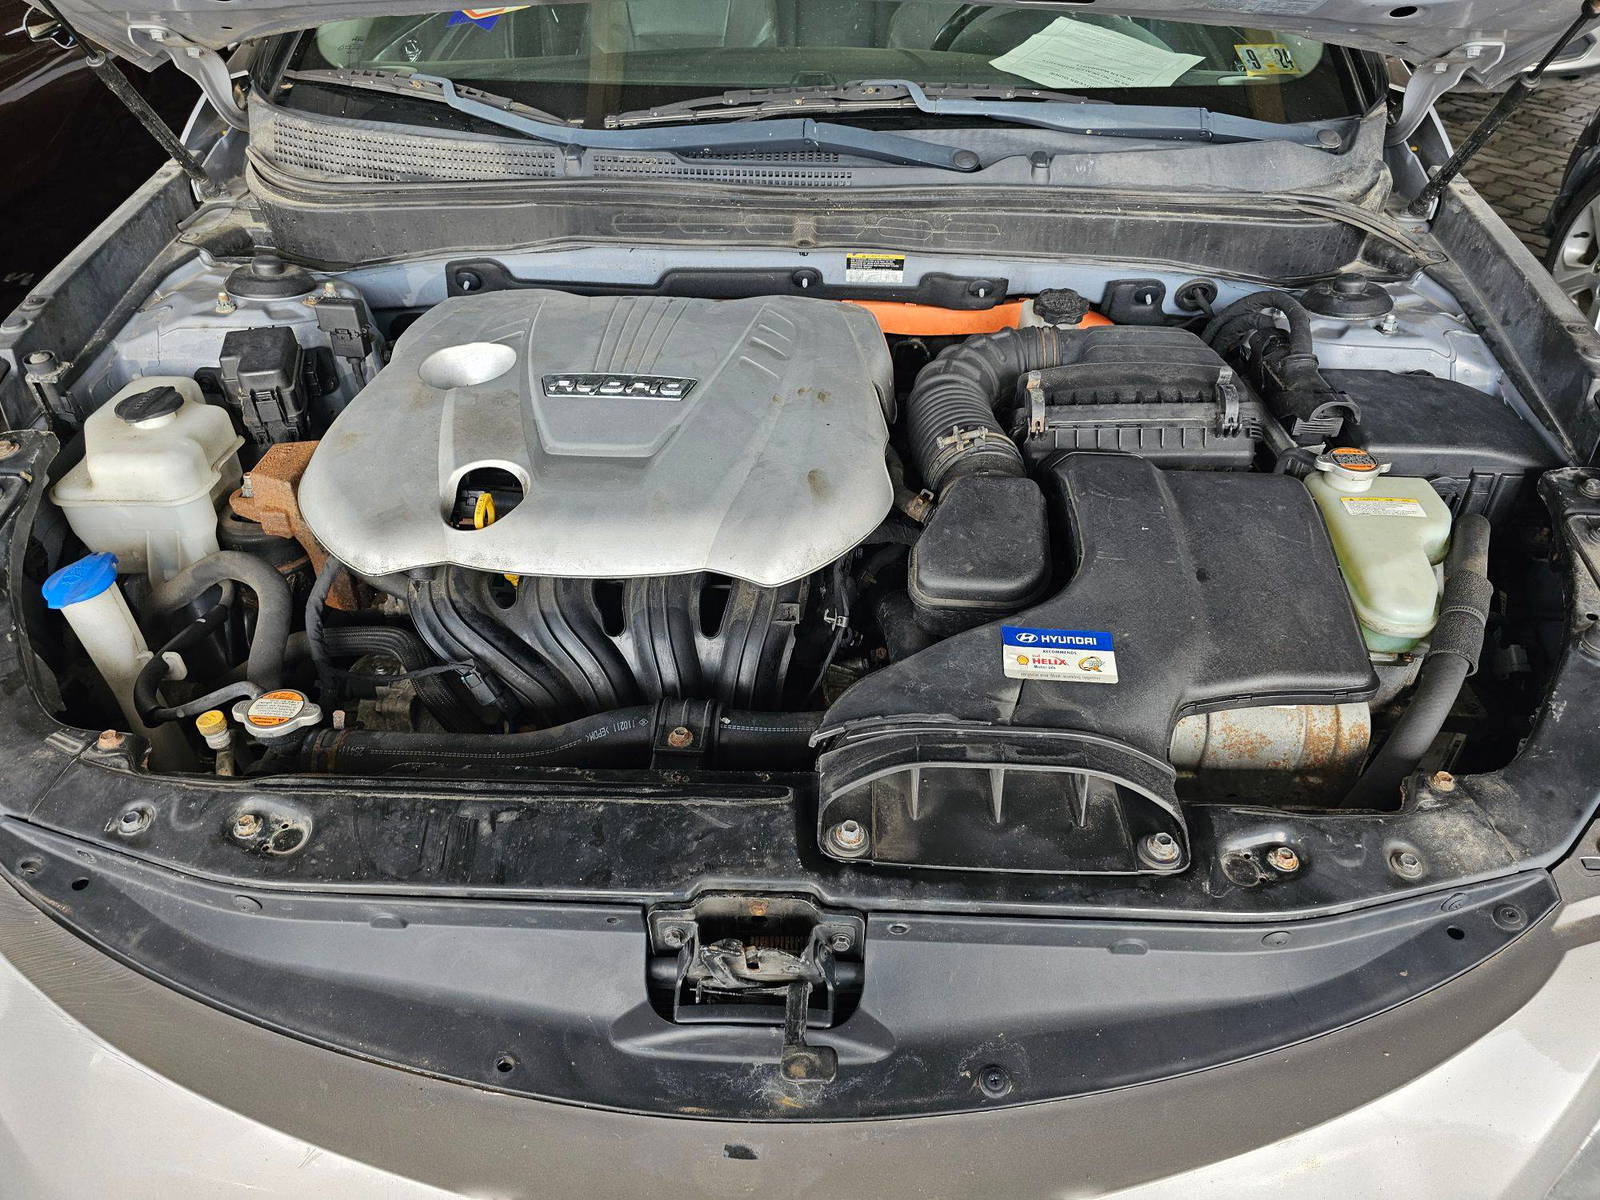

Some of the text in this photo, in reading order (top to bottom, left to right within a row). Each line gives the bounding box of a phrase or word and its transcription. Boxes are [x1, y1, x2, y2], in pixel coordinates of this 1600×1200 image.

[1245, 49, 1294, 69] 9 24
[1041, 635, 1097, 645] HYUNDAI
[1032, 658, 1070, 666] HELIX
